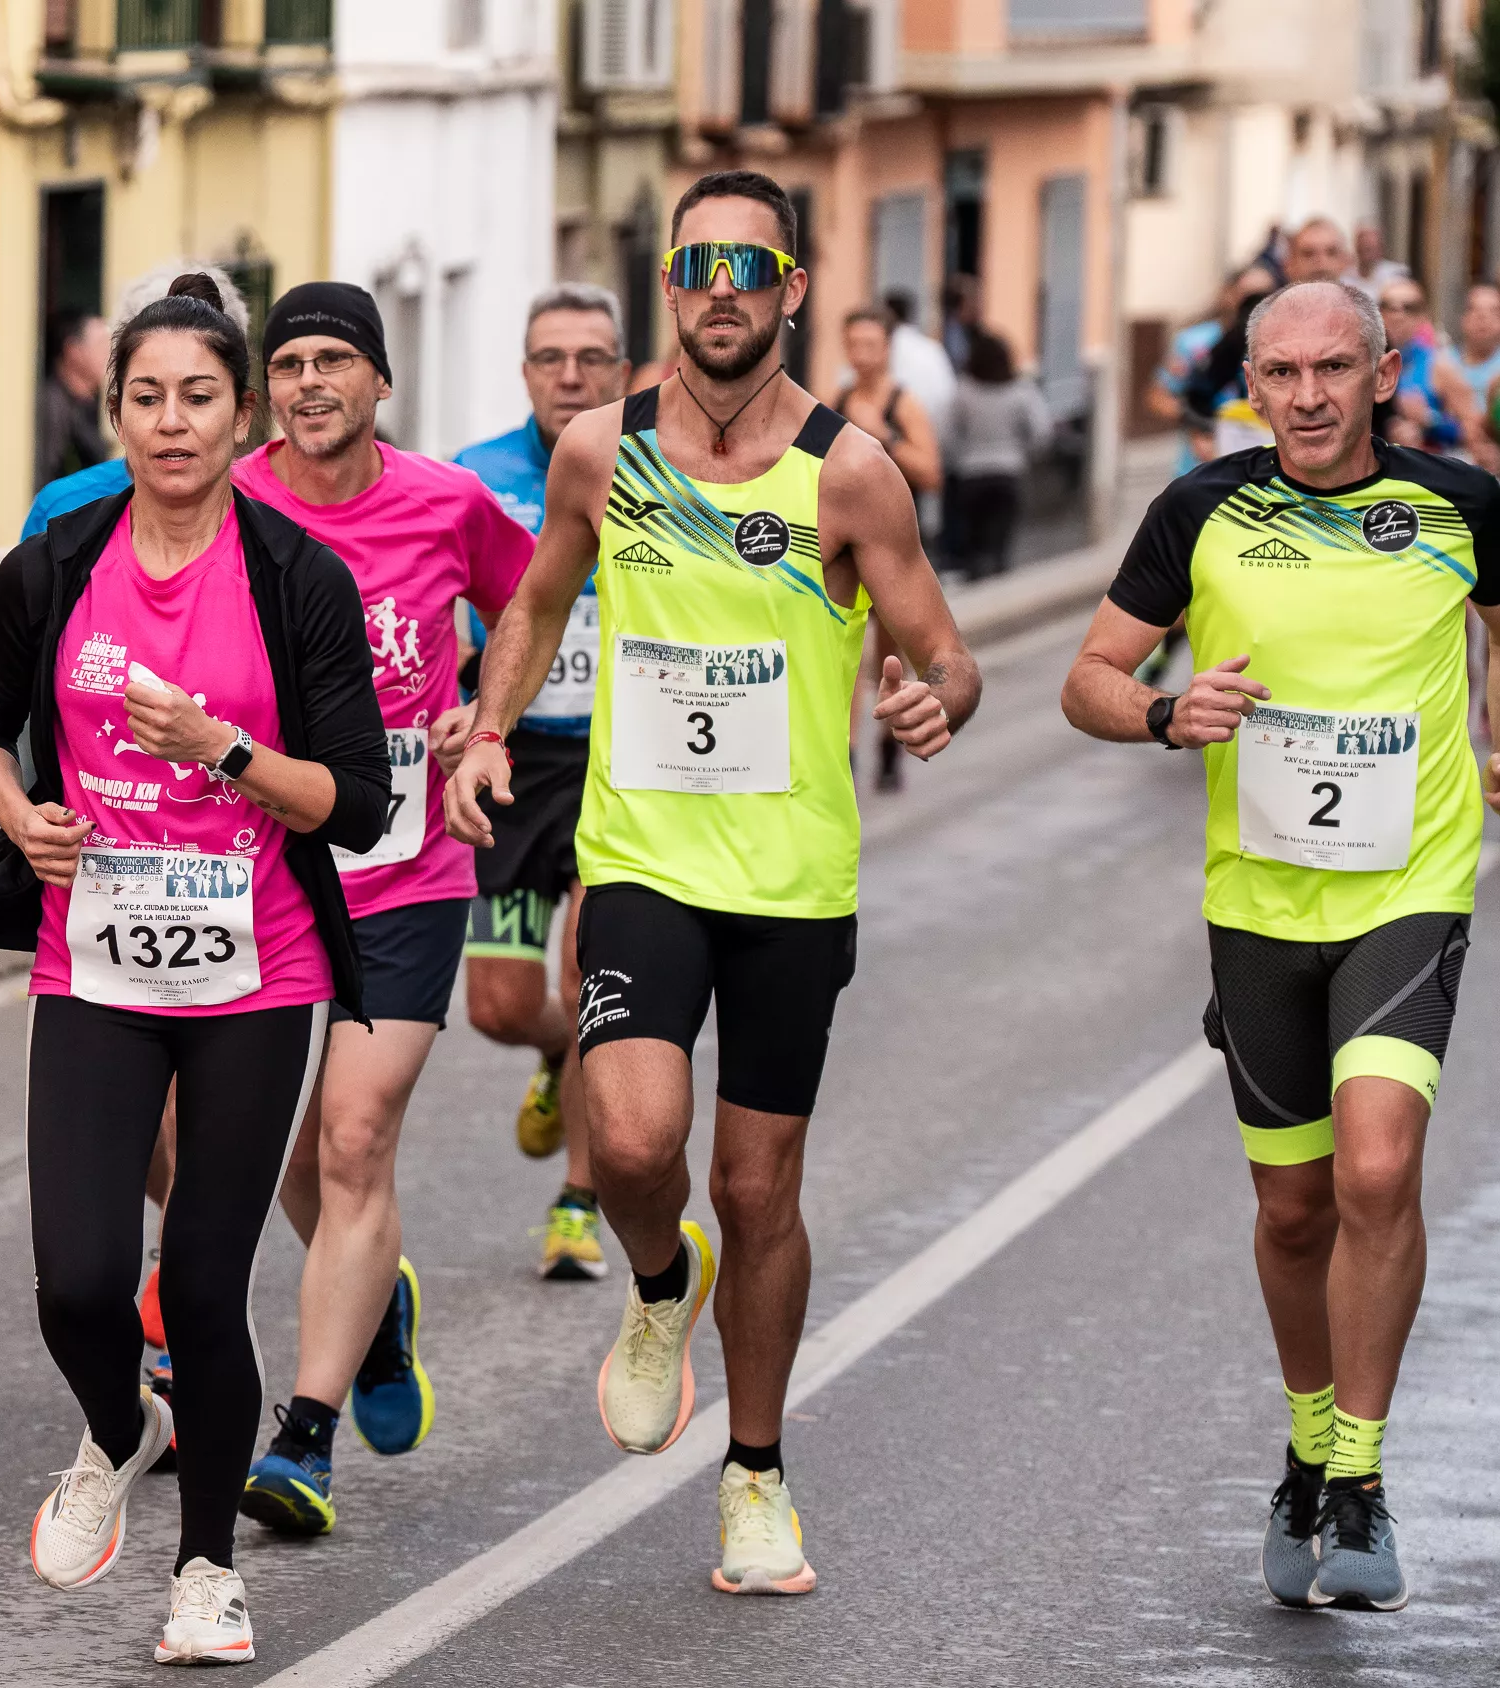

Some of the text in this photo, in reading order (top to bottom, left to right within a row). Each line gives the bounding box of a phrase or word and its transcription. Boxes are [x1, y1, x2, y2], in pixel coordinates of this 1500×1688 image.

[614, 562, 671, 575] ESMONSUR
[1240, 560, 1310, 570] ESMONSUR
[92, 631, 112, 644] XXV
[81, 640, 127, 660] CARRERA
[622, 640, 702, 657] CIRCUITO PROVINCIAL DE
[76, 653, 127, 668] POPULAR
[622, 648, 702, 665] CARRERAS POPULARES
[703, 649, 751, 668] 2024
[70, 668, 124, 686] LUCENA
[1281, 711, 1323, 724] PROVINCIAL
[1326, 717, 1335, 725] DE
[1337, 717, 1383, 734] 2024
[687, 711, 716, 755] 3
[1289, 720, 1335, 732] POPULARES
[656, 763, 696, 772] ALEJANDRO
[78, 770, 162, 801] SUMANDO KM
[113, 799, 122, 809] LA
[122, 800, 159, 812] IGUALDAD
[1308, 781, 1342, 828] 2
[1290, 837, 1320, 845] MANUEL
[108, 856, 152, 867] PROVINCIAL
[155, 857, 164, 866] DE
[166, 856, 214, 877] 2024
[116, 865, 164, 875] POPULARES
[130, 874, 164, 882] CÓRDOBA
[96, 924, 236, 969] 1323
[128, 977, 159, 985] SORAYA
[182, 977, 210, 985] RAMOS
[593, 1017, 604, 1028] del
[607, 1009, 630, 1022] Canal
